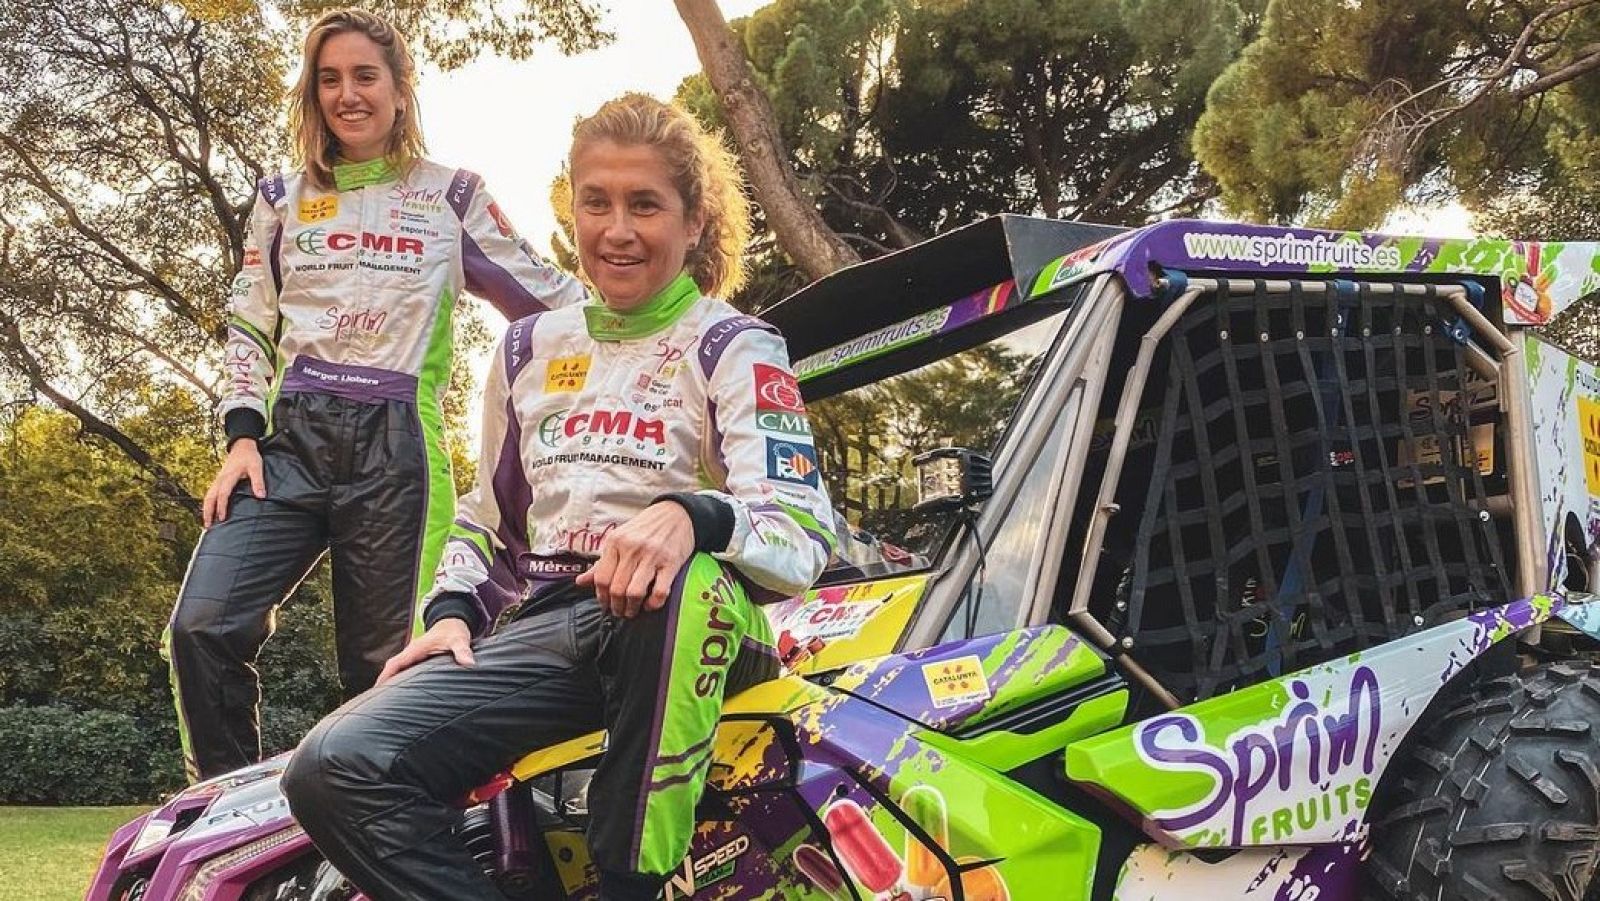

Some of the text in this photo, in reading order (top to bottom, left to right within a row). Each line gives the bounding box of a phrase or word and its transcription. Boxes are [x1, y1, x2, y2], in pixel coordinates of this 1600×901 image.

[326, 231, 425, 256] CMR
[1187, 235, 1400, 267] www.sprimfruits.es
[295, 260, 423, 275] WORLD FRUIT MANAGEMENT
[564, 409, 666, 445] CMR
[582, 435, 665, 456] group
[1141, 665, 1381, 847] Sprim
[1250, 777, 1373, 846] FRUITS
